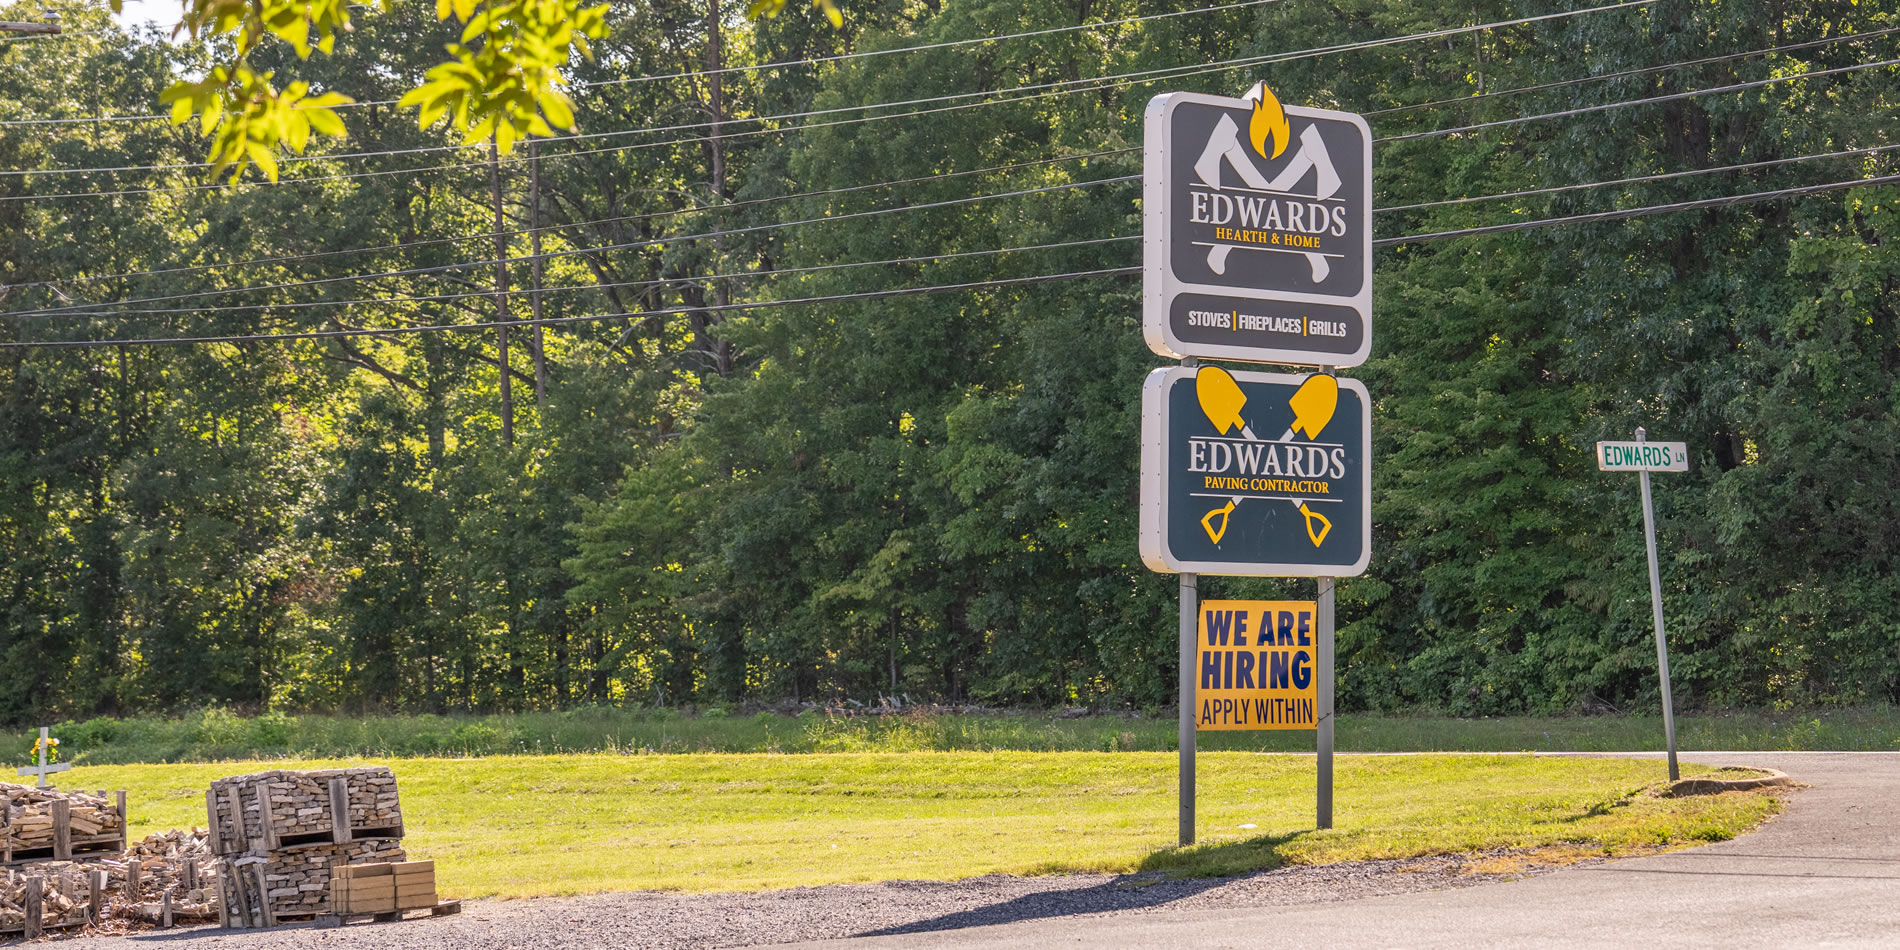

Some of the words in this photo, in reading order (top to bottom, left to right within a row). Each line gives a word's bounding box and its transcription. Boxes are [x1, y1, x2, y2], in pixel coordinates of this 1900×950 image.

[1189, 191, 1347, 237] EDWARDS
[1215, 227, 1267, 244] HEARTH
[1271, 232, 1280, 245] &
[1284, 234, 1321, 248] HOME
[1188, 310, 1231, 329] STOVES
[1239, 314, 1301, 334] FIREPLACES
[1309, 319, 1346, 337] GRILLS
[1187, 440, 1345, 480] EDWARDS
[1604, 446, 1671, 467] EDWARDS
[1675, 452, 1685, 462] LN
[1204, 476, 1249, 491] PAVING
[1250, 478, 1329, 494] CONTRACTOR
[1205, 610, 1248, 647] WE
[1257, 610, 1311, 647] ARE
[1201, 650, 1311, 690] HIRING
[1201, 698, 1250, 725] APPLY
[1254, 698, 1313, 725] WITHIN
